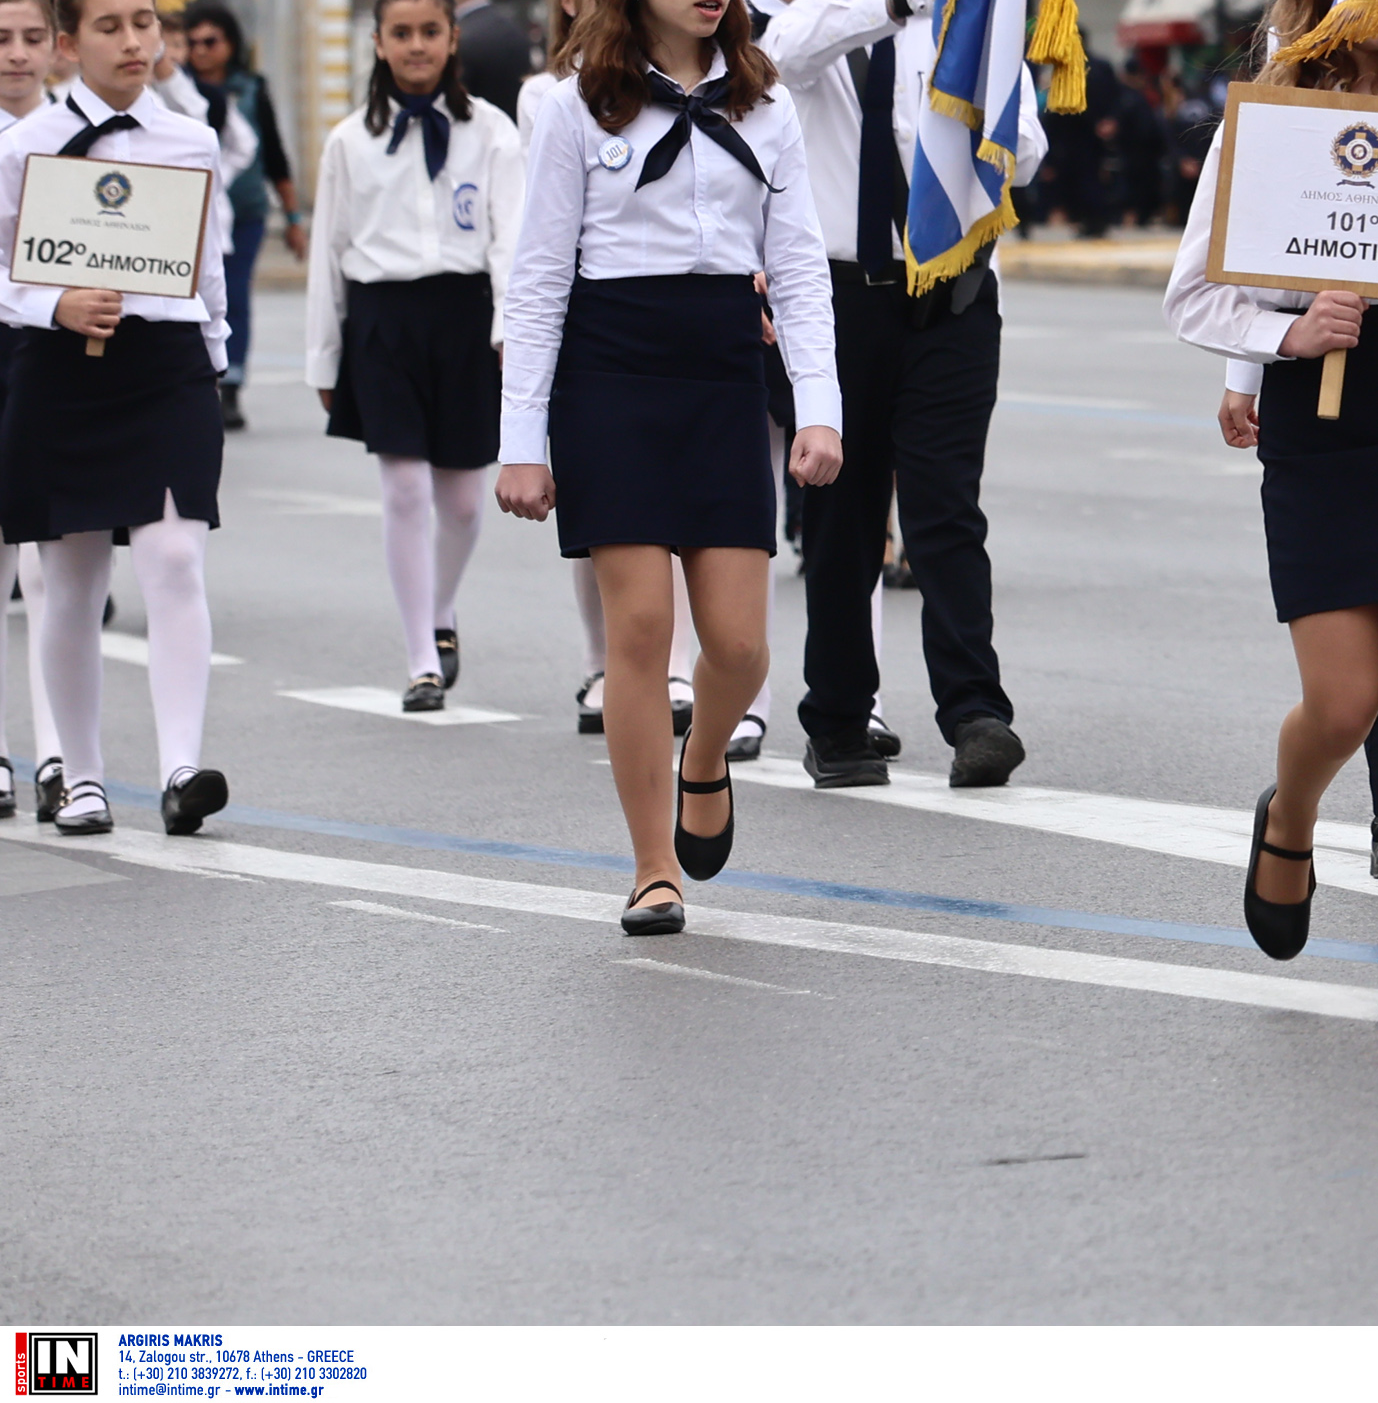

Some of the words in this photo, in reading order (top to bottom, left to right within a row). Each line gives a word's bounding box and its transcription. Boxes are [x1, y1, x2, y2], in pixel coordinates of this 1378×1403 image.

[606, 144, 623, 161] 101
[1300, 190, 1343, 202] ΔΗΜΟΣ
[86, 253, 192, 278] ΔΗΜΟΤΙΚΟ
